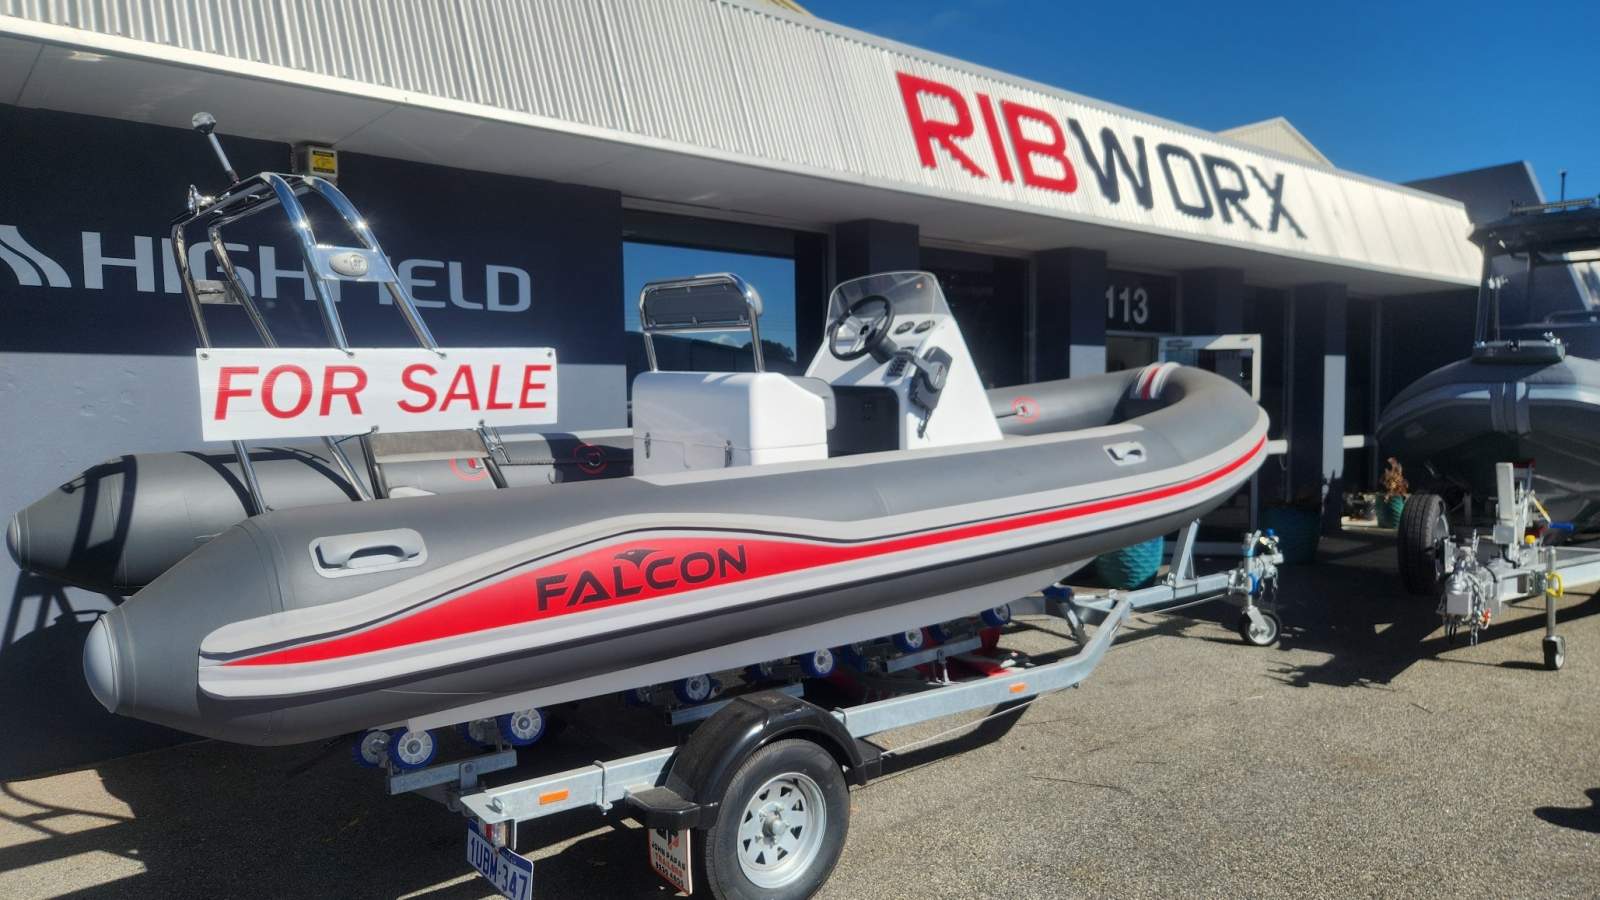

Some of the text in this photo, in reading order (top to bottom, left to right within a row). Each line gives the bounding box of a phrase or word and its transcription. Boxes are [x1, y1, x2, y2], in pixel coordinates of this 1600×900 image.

[82, 231, 531, 312] HIGHELD
[1105, 285, 1148, 324] 113
[214, 363, 552, 420] FOR SALE
[536, 544, 747, 611] FALCON
